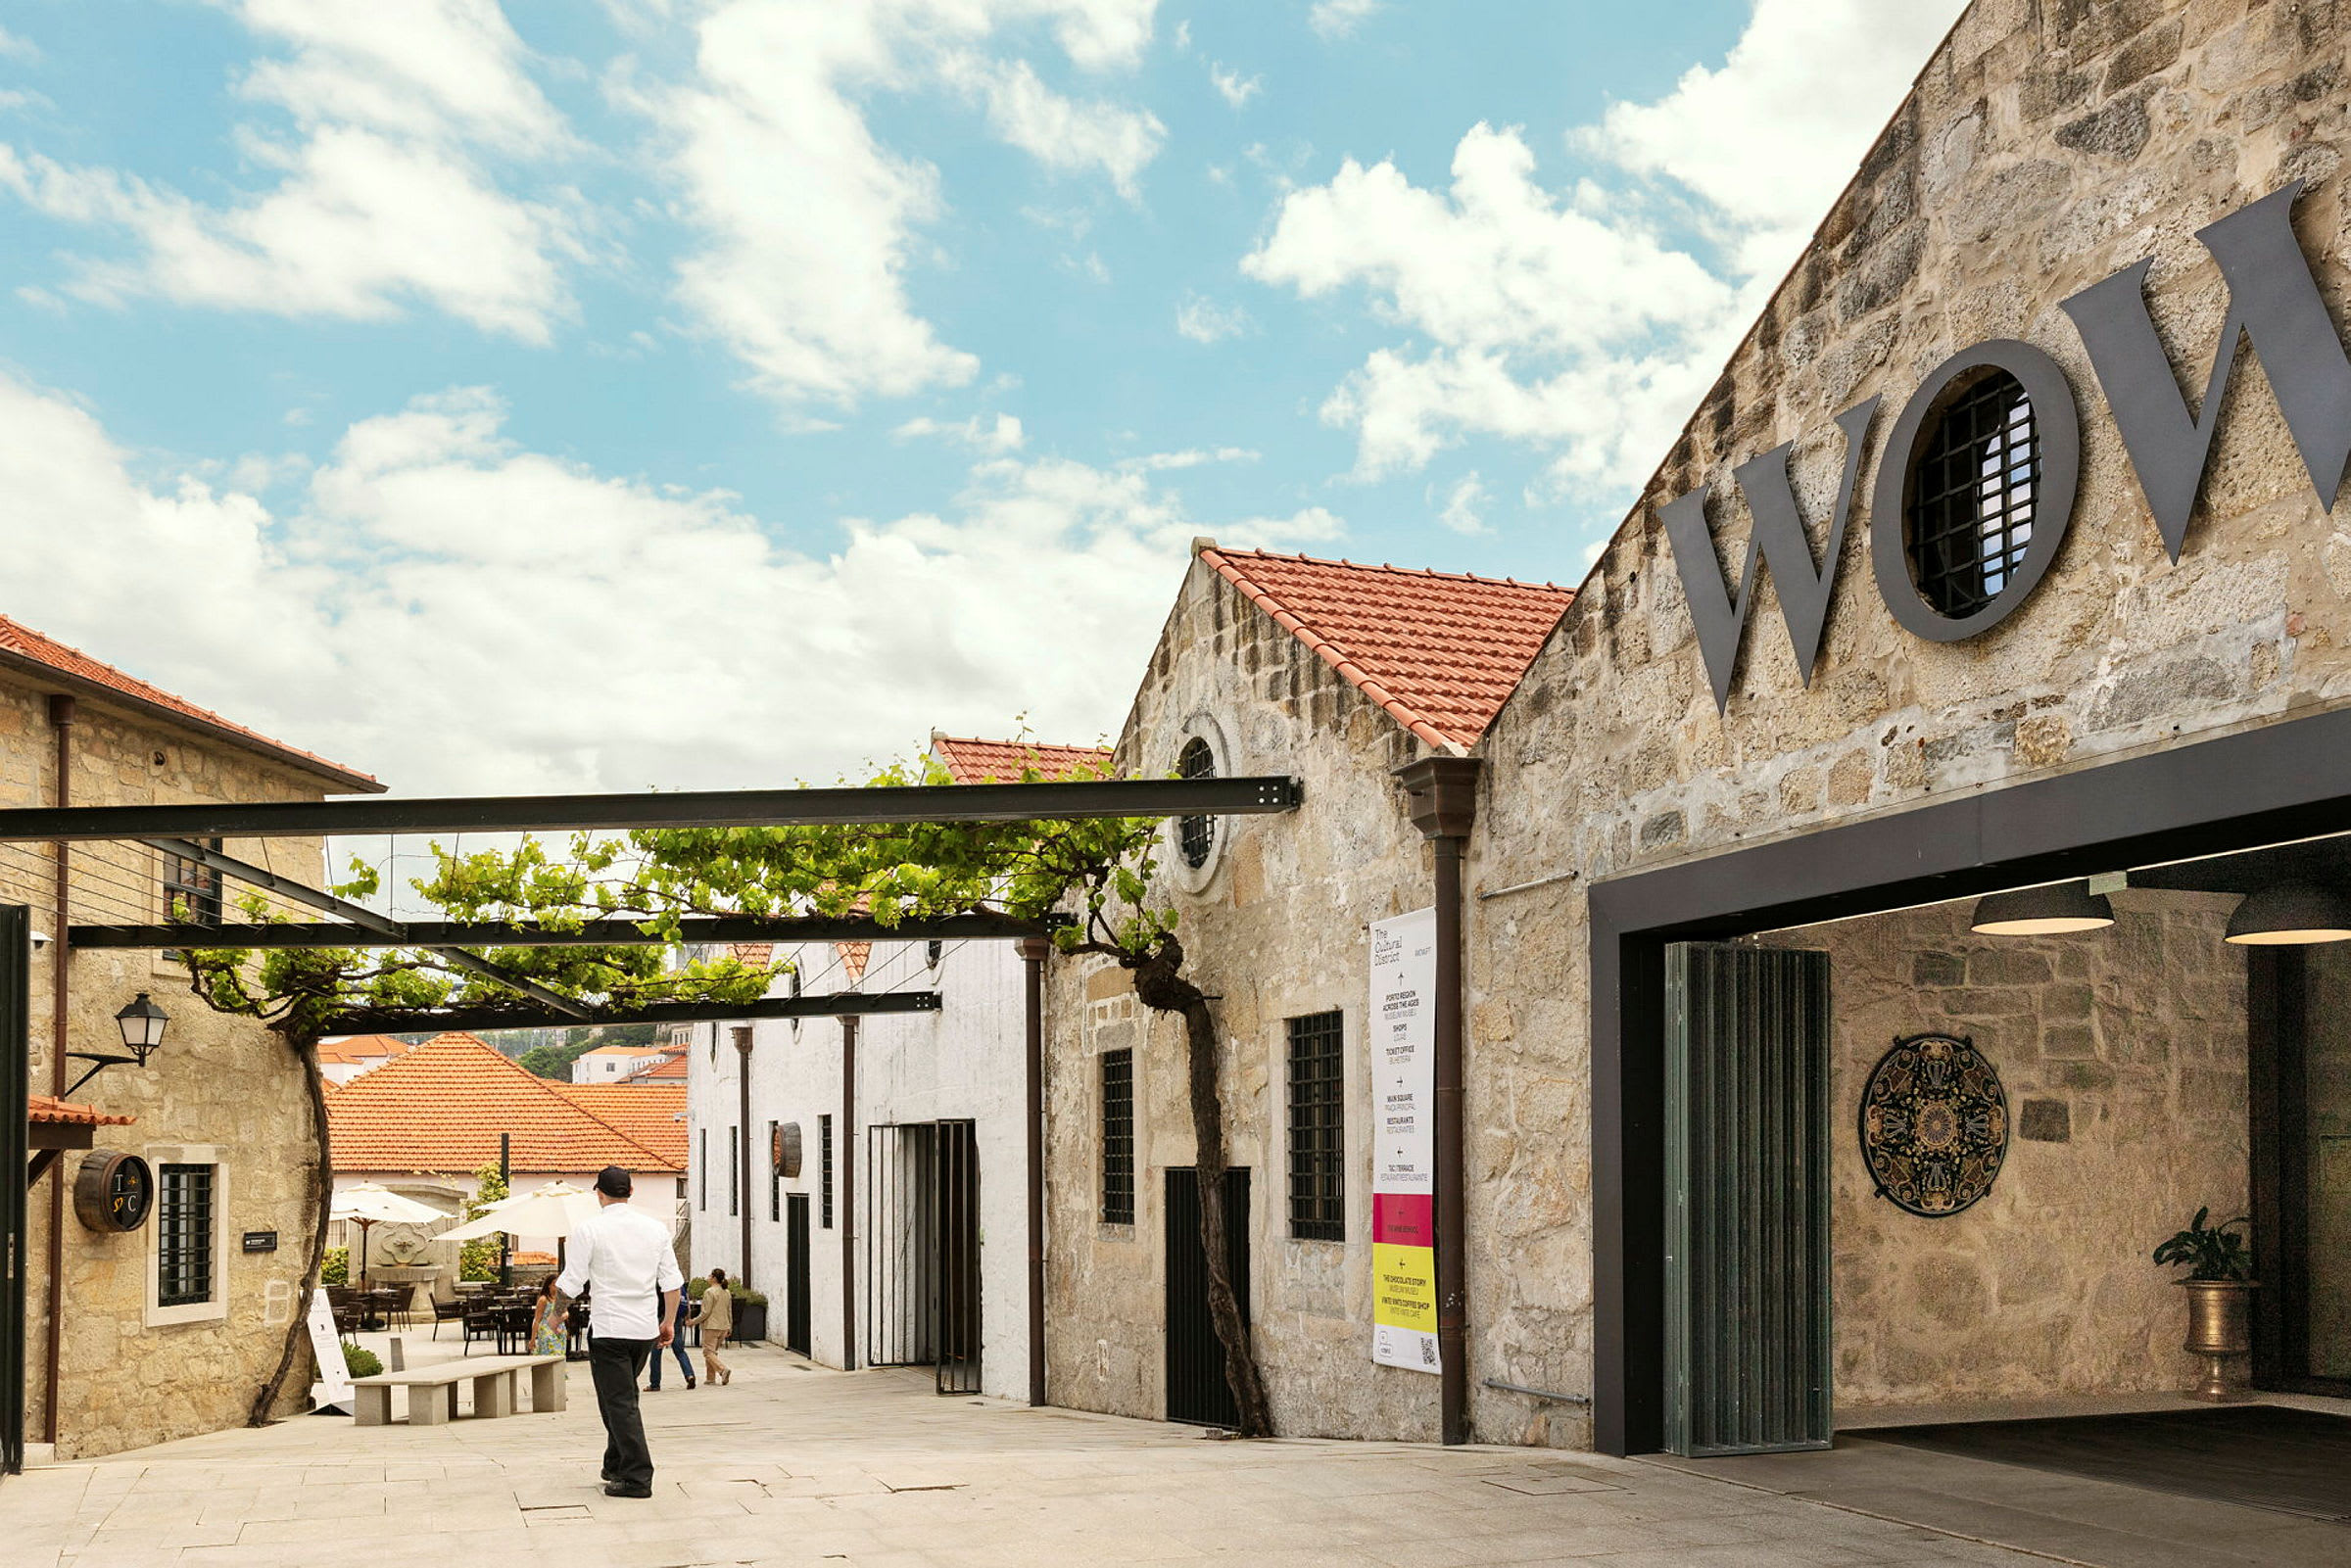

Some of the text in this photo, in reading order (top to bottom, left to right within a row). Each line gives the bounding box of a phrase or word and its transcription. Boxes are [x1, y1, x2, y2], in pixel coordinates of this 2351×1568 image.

[1657, 179, 2351, 719] WOW
[1375, 929, 1388, 940] The
[1374, 935, 1402, 954] Cultural
[1393, 1023, 1407, 1032] SHOPS
[1400, 1044, 1415, 1054] OFFICE
[1398, 1093, 1413, 1102] SQUARE
[1386, 1117, 1414, 1125] RESTAURANTS
[115, 1174, 122, 1191] T
[127, 1195, 137, 1212] C
